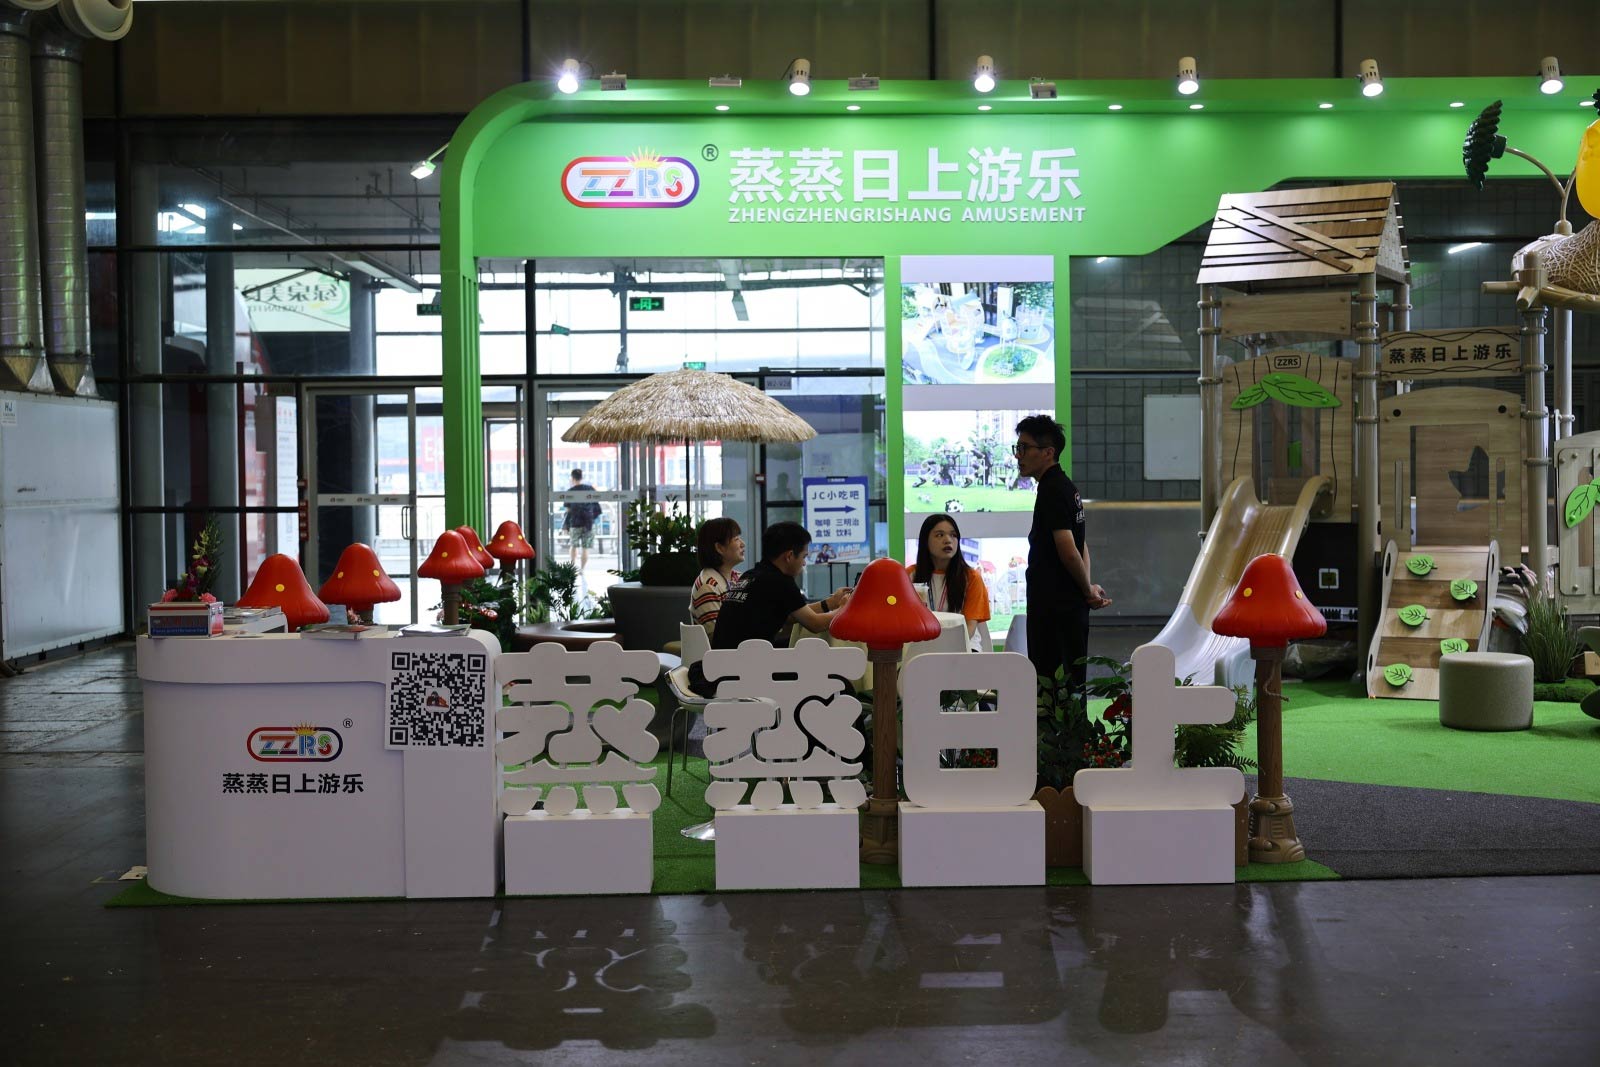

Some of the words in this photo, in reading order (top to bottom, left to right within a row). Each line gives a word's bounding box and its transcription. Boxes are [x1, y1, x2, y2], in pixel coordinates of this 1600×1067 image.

[579, 167, 684, 200] ZZRS
[728, 147, 1082, 203] 蒸蒸日上游乐
[728, 207, 952, 223] ZHENGZHENGRISHANG
[961, 206, 1086, 222] AMUSEMENT
[1276, 357, 1299, 367] ZZRS
[1389, 343, 1512, 364] 蒸蒸日上游乐
[259, 733, 333, 756] ZZRS
[222, 773, 364, 794] 蒸蒸日上游乐
